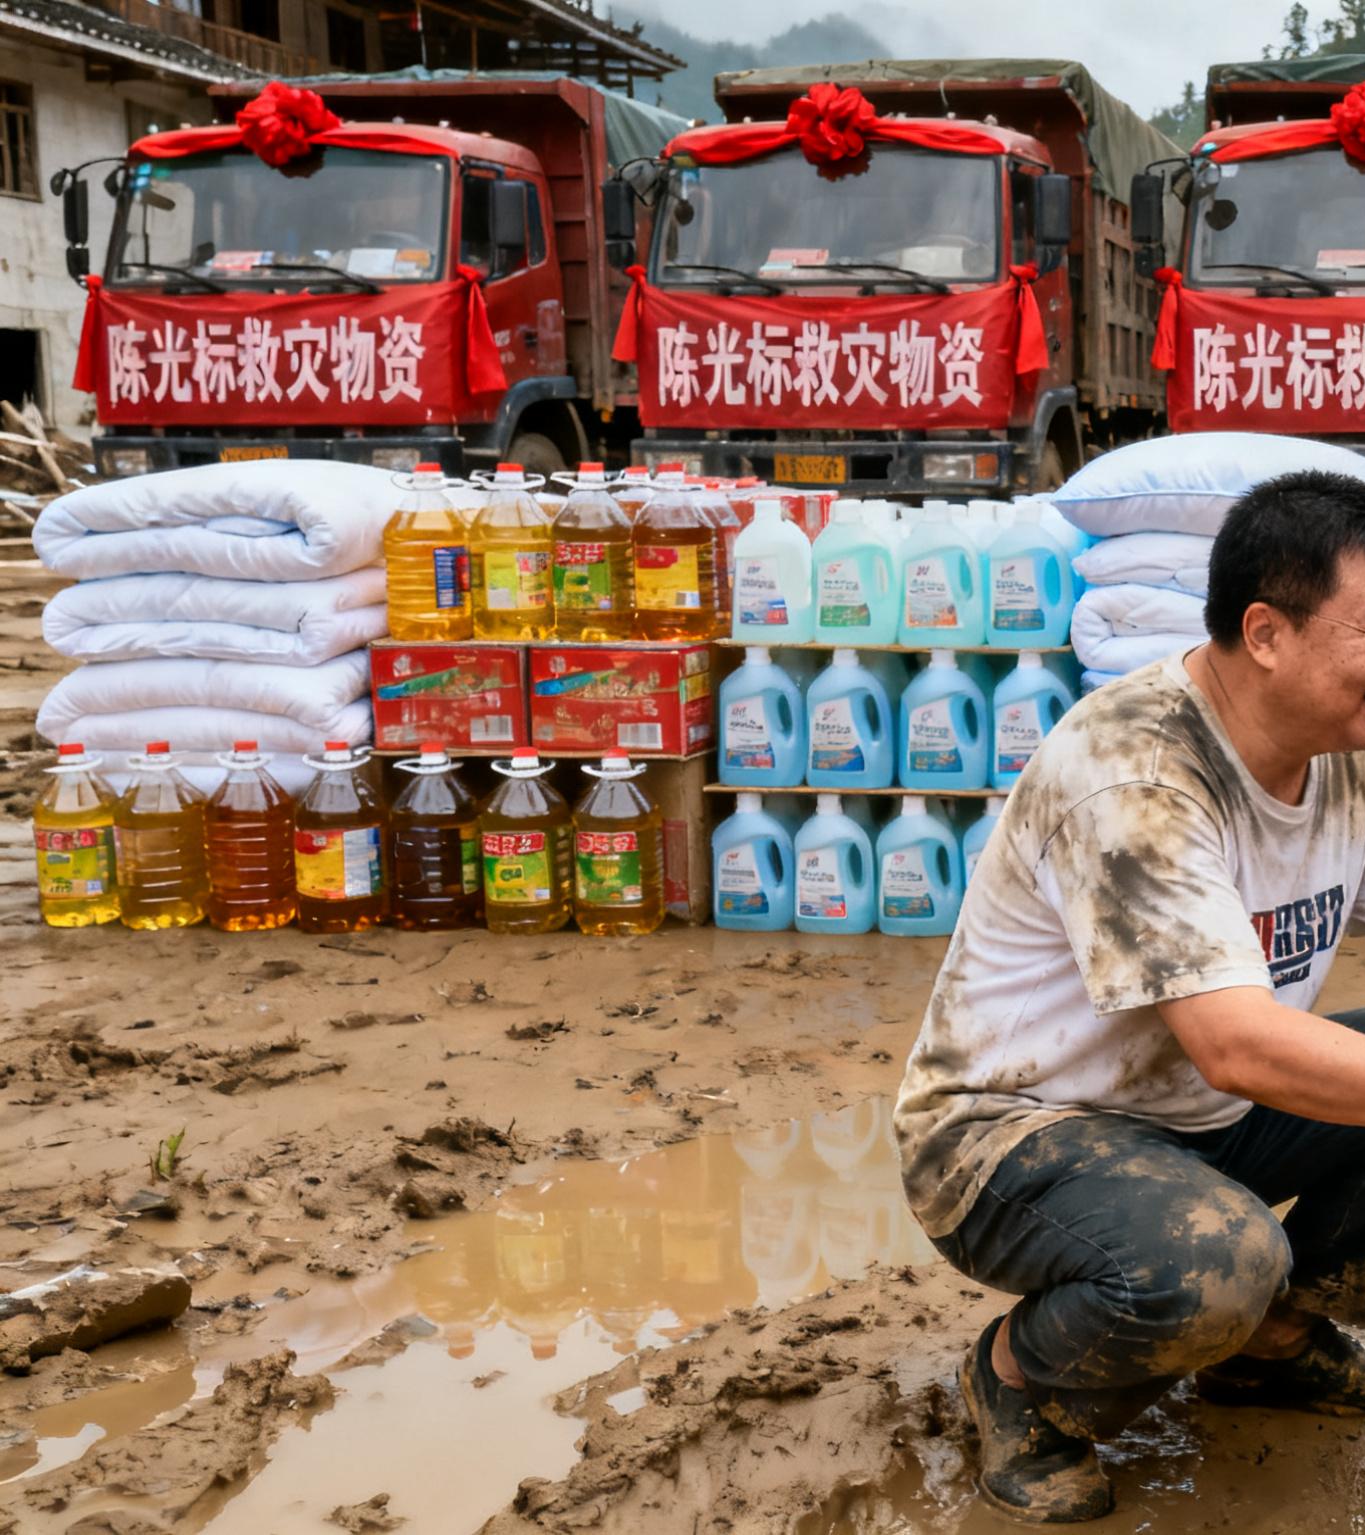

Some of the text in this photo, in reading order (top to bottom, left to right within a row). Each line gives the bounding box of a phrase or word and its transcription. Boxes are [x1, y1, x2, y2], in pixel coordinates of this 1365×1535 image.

[107, 315, 425, 407] 陈光标救灾物资
[658, 320, 984, 408] 陈光标救灾物资
